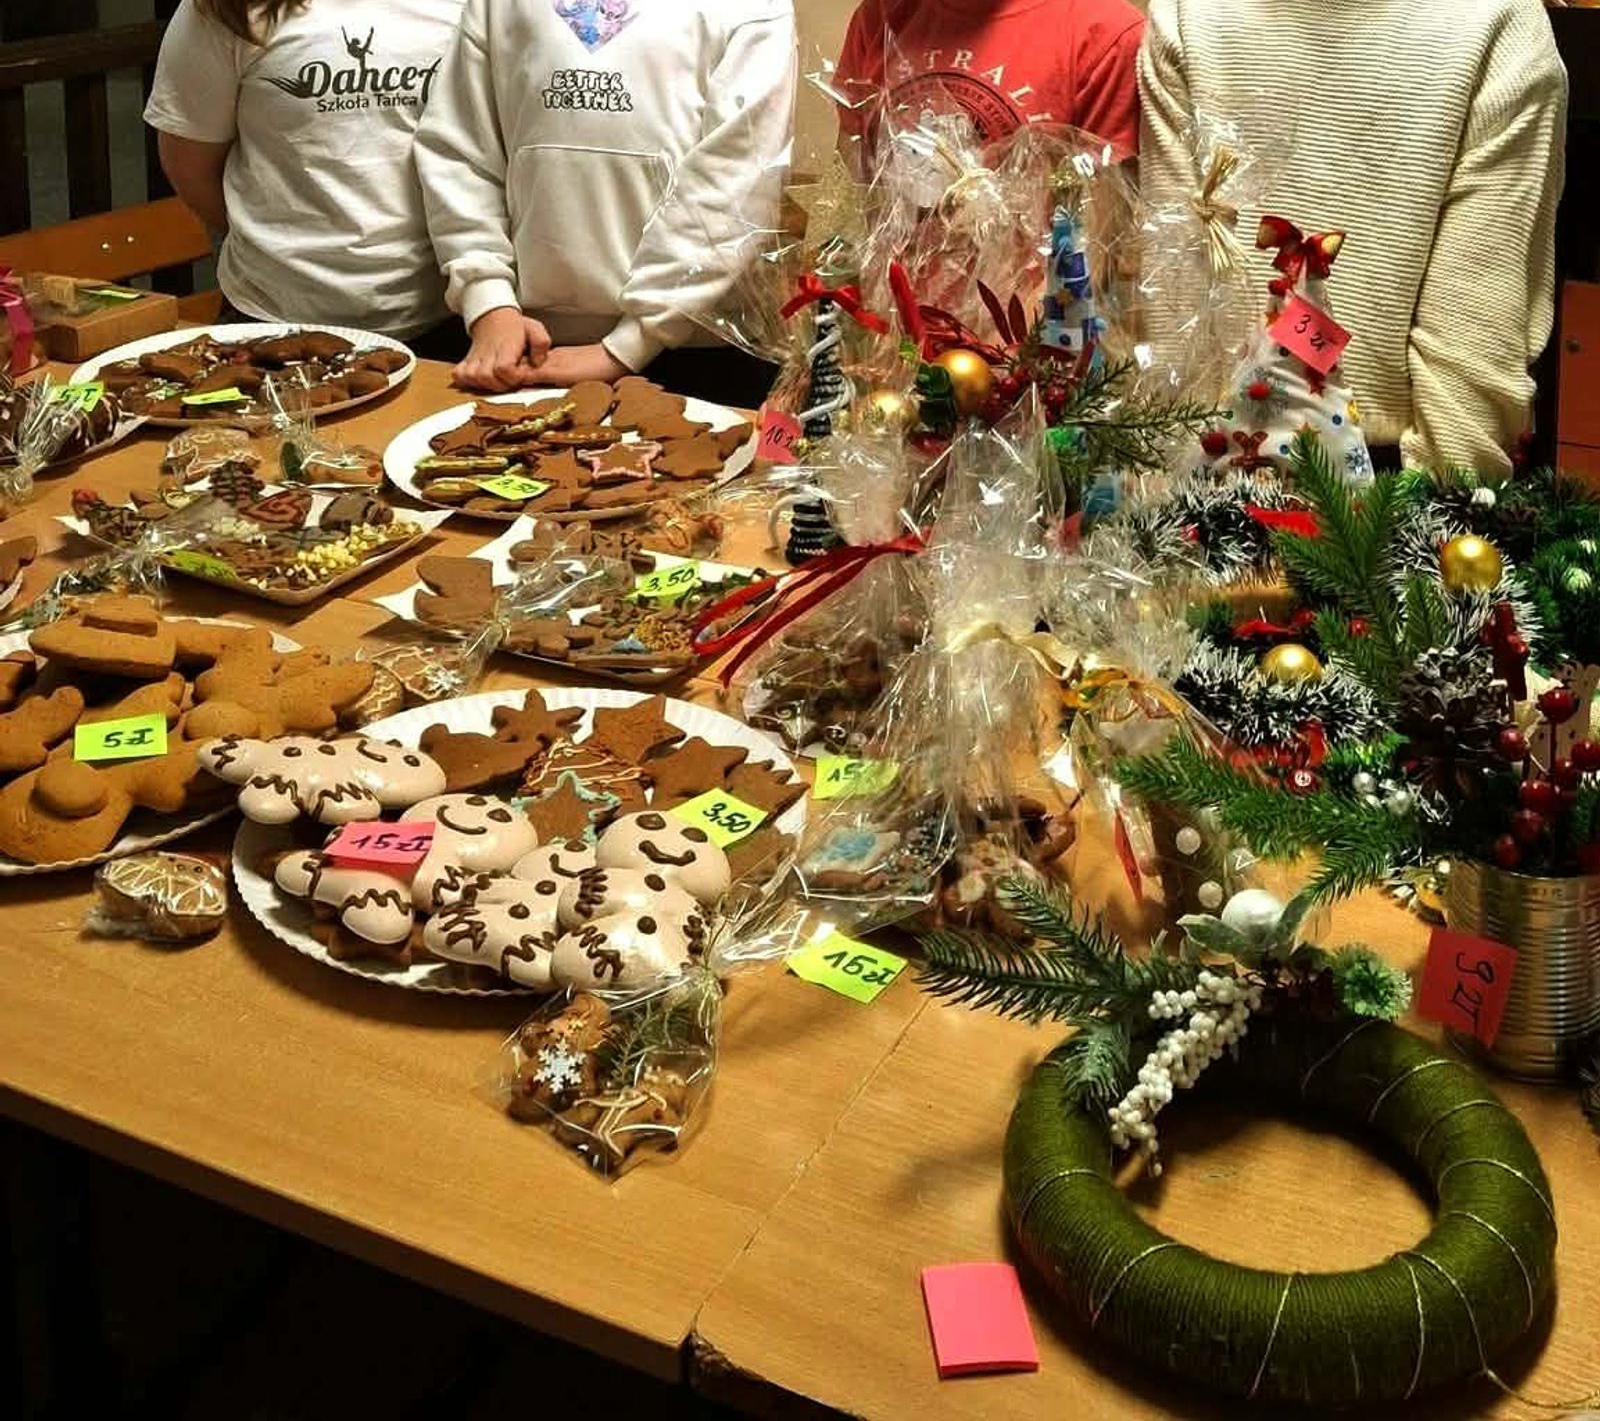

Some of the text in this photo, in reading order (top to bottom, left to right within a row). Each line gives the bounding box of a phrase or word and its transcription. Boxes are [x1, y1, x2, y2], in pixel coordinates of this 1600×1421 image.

[298, 57, 442, 104] Dancer
[551, 69, 624, 91] BETTER
[316, 92, 418, 113] Szkoła Tańca
[542, 88, 633, 112] TOGETHER
[702, 801, 753, 834] 3,50
